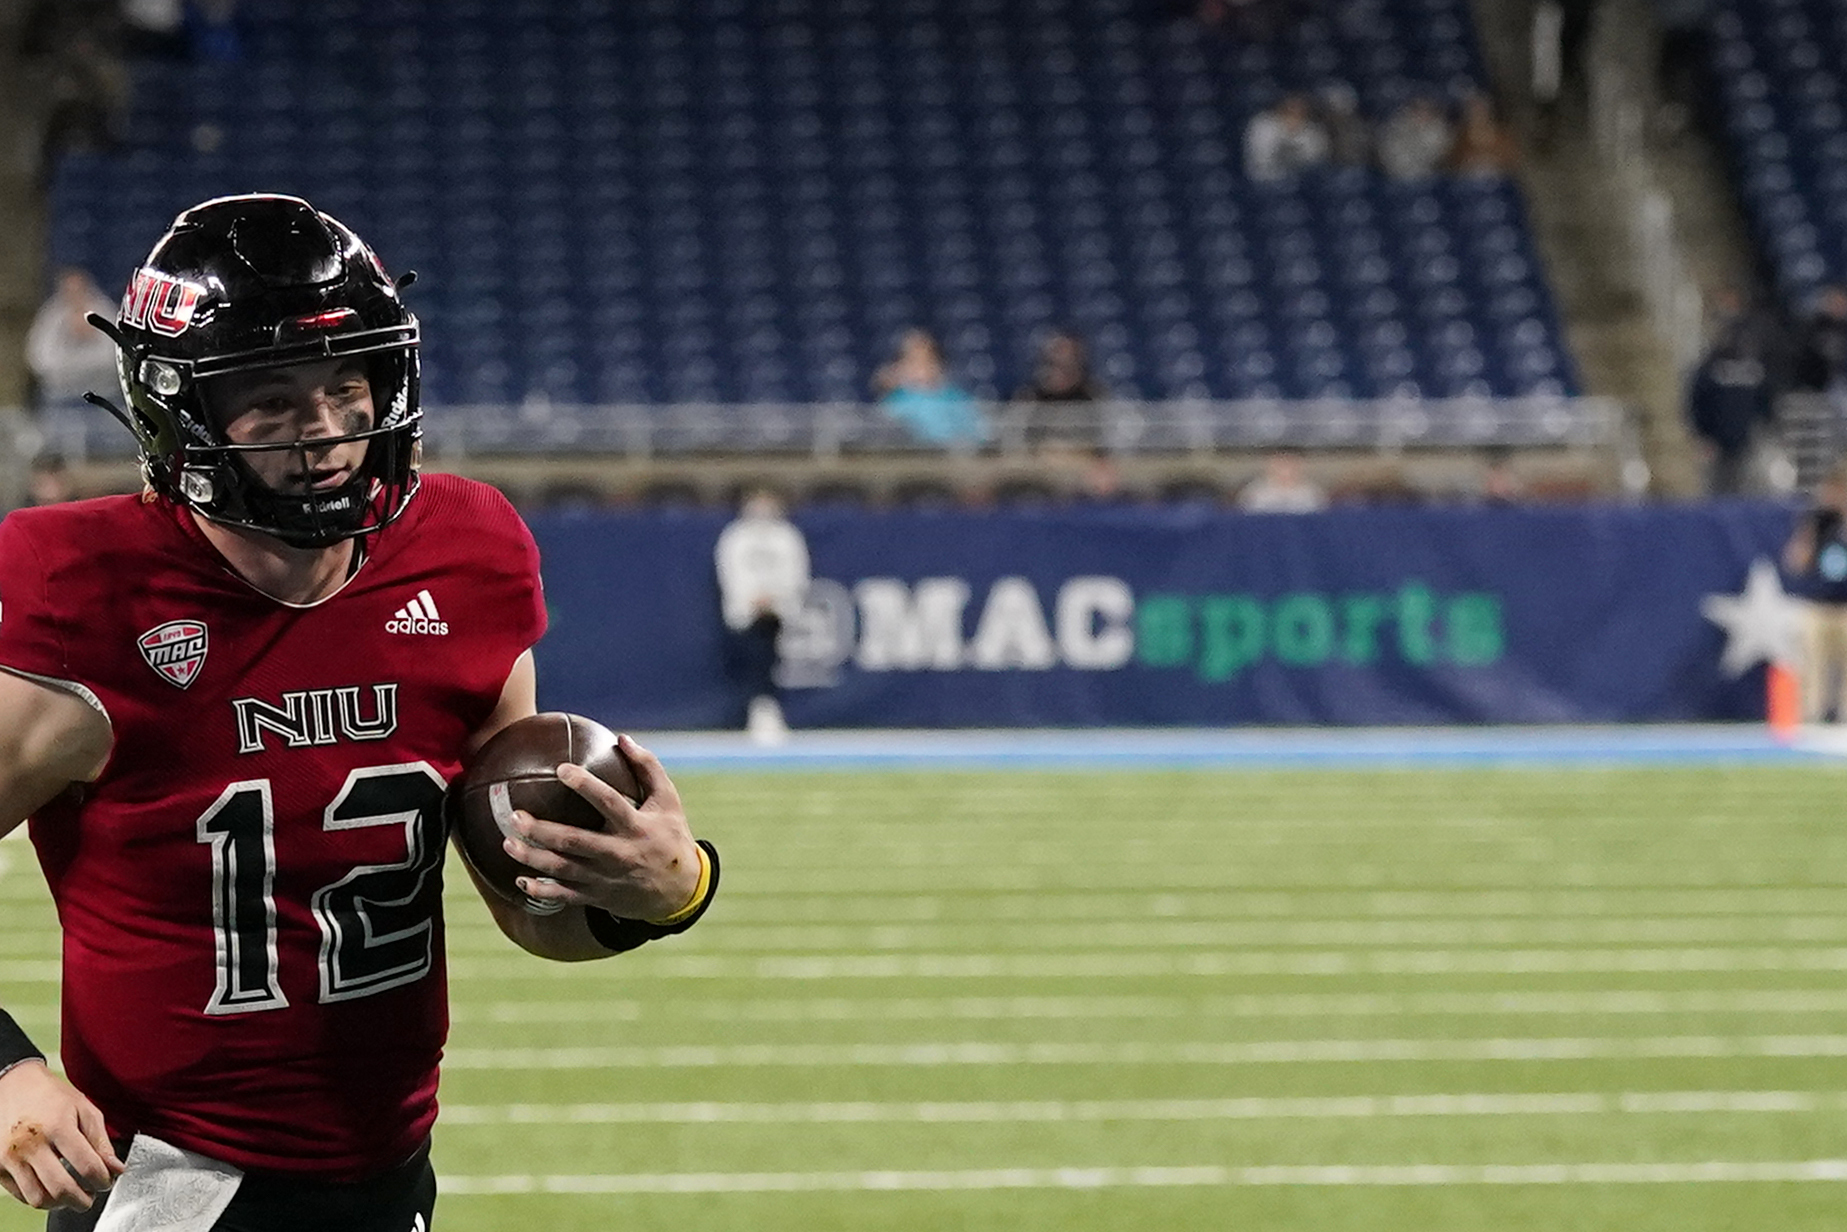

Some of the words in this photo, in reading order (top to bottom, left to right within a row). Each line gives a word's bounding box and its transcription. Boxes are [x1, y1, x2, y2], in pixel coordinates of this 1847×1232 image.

[385, 616, 449, 635] adidas
[148, 637, 206, 666] MAC
[233, 683, 398, 753] NIU
[196, 760, 450, 1016] 12
